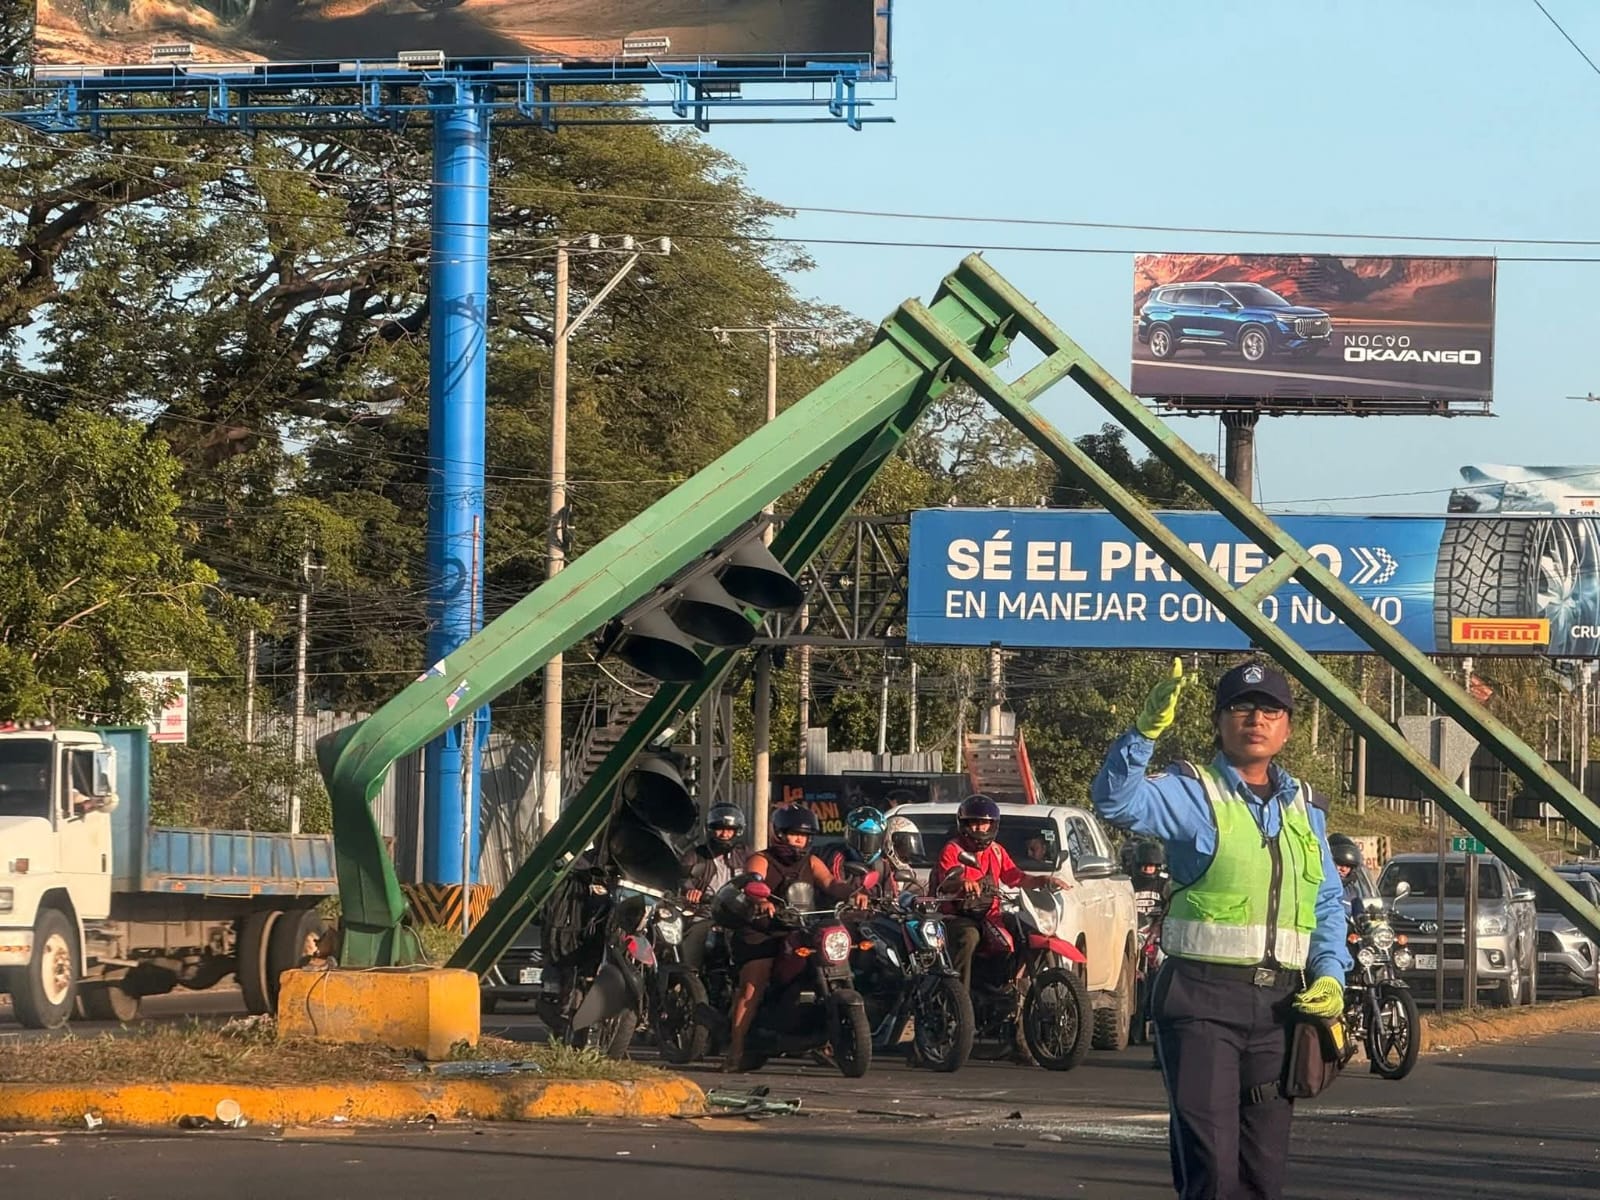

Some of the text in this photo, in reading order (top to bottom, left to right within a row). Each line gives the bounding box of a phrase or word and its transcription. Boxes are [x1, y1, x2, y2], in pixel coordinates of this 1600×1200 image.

[946, 529, 1342, 584] SÉ EL PRMEO
[946, 590, 986, 619] EN
[999, 591, 1147, 622] MANEJAR
[1462, 622, 1540, 641] PIRELLI
